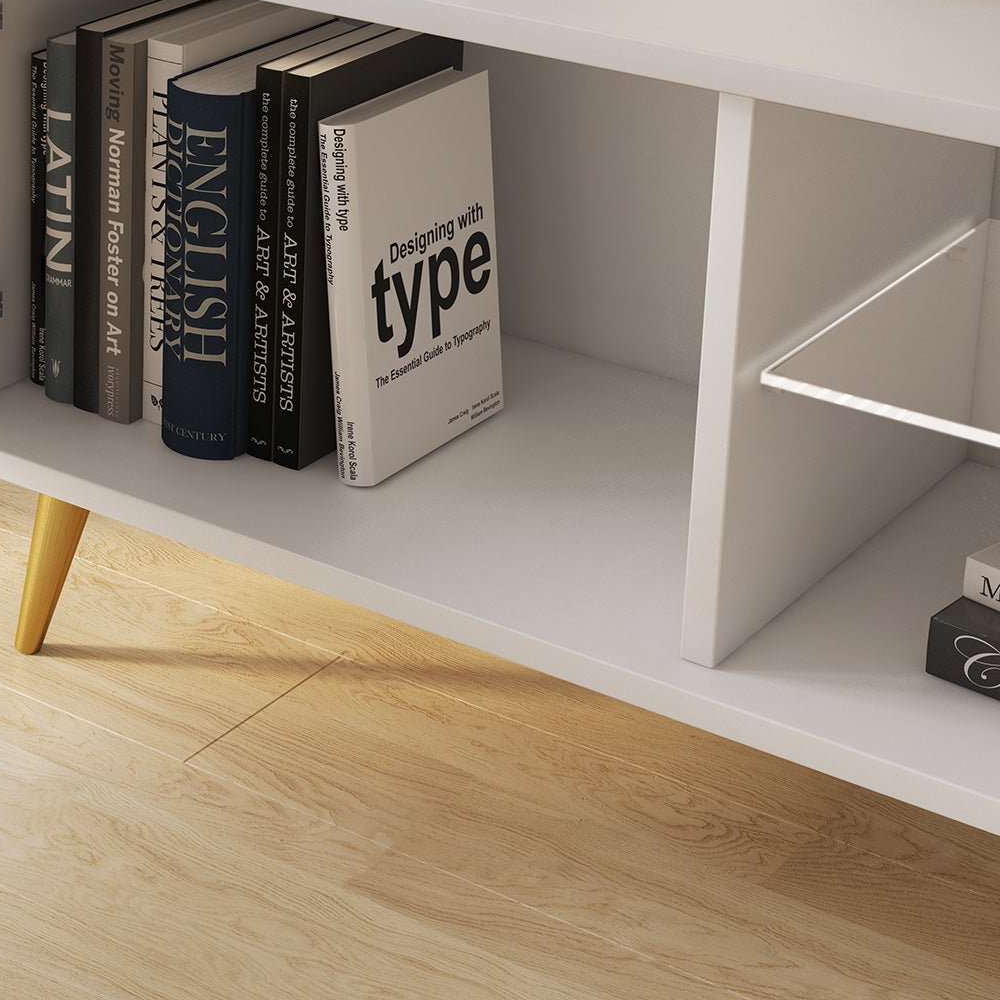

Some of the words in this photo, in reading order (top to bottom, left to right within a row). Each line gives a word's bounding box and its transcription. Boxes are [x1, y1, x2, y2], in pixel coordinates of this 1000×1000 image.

[106, 44, 125, 123] Moving
[262, 92, 270, 113] the
[289, 98, 298, 119] the
[260, 115, 269, 171] complete
[287, 121, 297, 178] complete
[332, 128, 348, 182] Designing
[107, 127, 125, 214] Norman
[259, 172, 268, 206] guide
[321, 151, 330, 194] Essential
[46, 108, 72, 273] LATIN
[286, 179, 295, 213] guide
[323, 195, 331, 221] Guide
[336, 184, 349, 206] with
[260, 208, 267, 221] to
[286, 215, 294, 228] to
[325, 223, 331, 232] to
[336, 208, 349, 232] type
[389, 219, 455, 265] Designing
[457, 202, 484, 230] with
[106, 218, 124, 287] Foster
[165, 118, 184, 361] DICTIONARY
[183, 122, 229, 367] ENGLISH
[256, 225, 270, 277] ART
[283, 232, 298, 285] ART
[325, 234, 335, 286] Typography
[106, 292, 121, 317] on
[255, 280, 269, 300] &
[282, 288, 297, 309] &
[371, 231, 491, 359] type
[106, 321, 122, 356] Art
[253, 303, 268, 404] ARTISTS
[375, 375, 390, 389] The
[390, 354, 423, 381] Essential
[423, 345, 444, 363] Guide
[444, 340, 452, 351] to
[453, 319, 491, 348] Typography
[279, 311, 295, 412] ARTISTS
[175, 426, 227, 441] CENTURY
[347, 421, 355, 440] Irene
[347, 440, 357, 460] Korol
[349, 462, 358, 481] Scala
